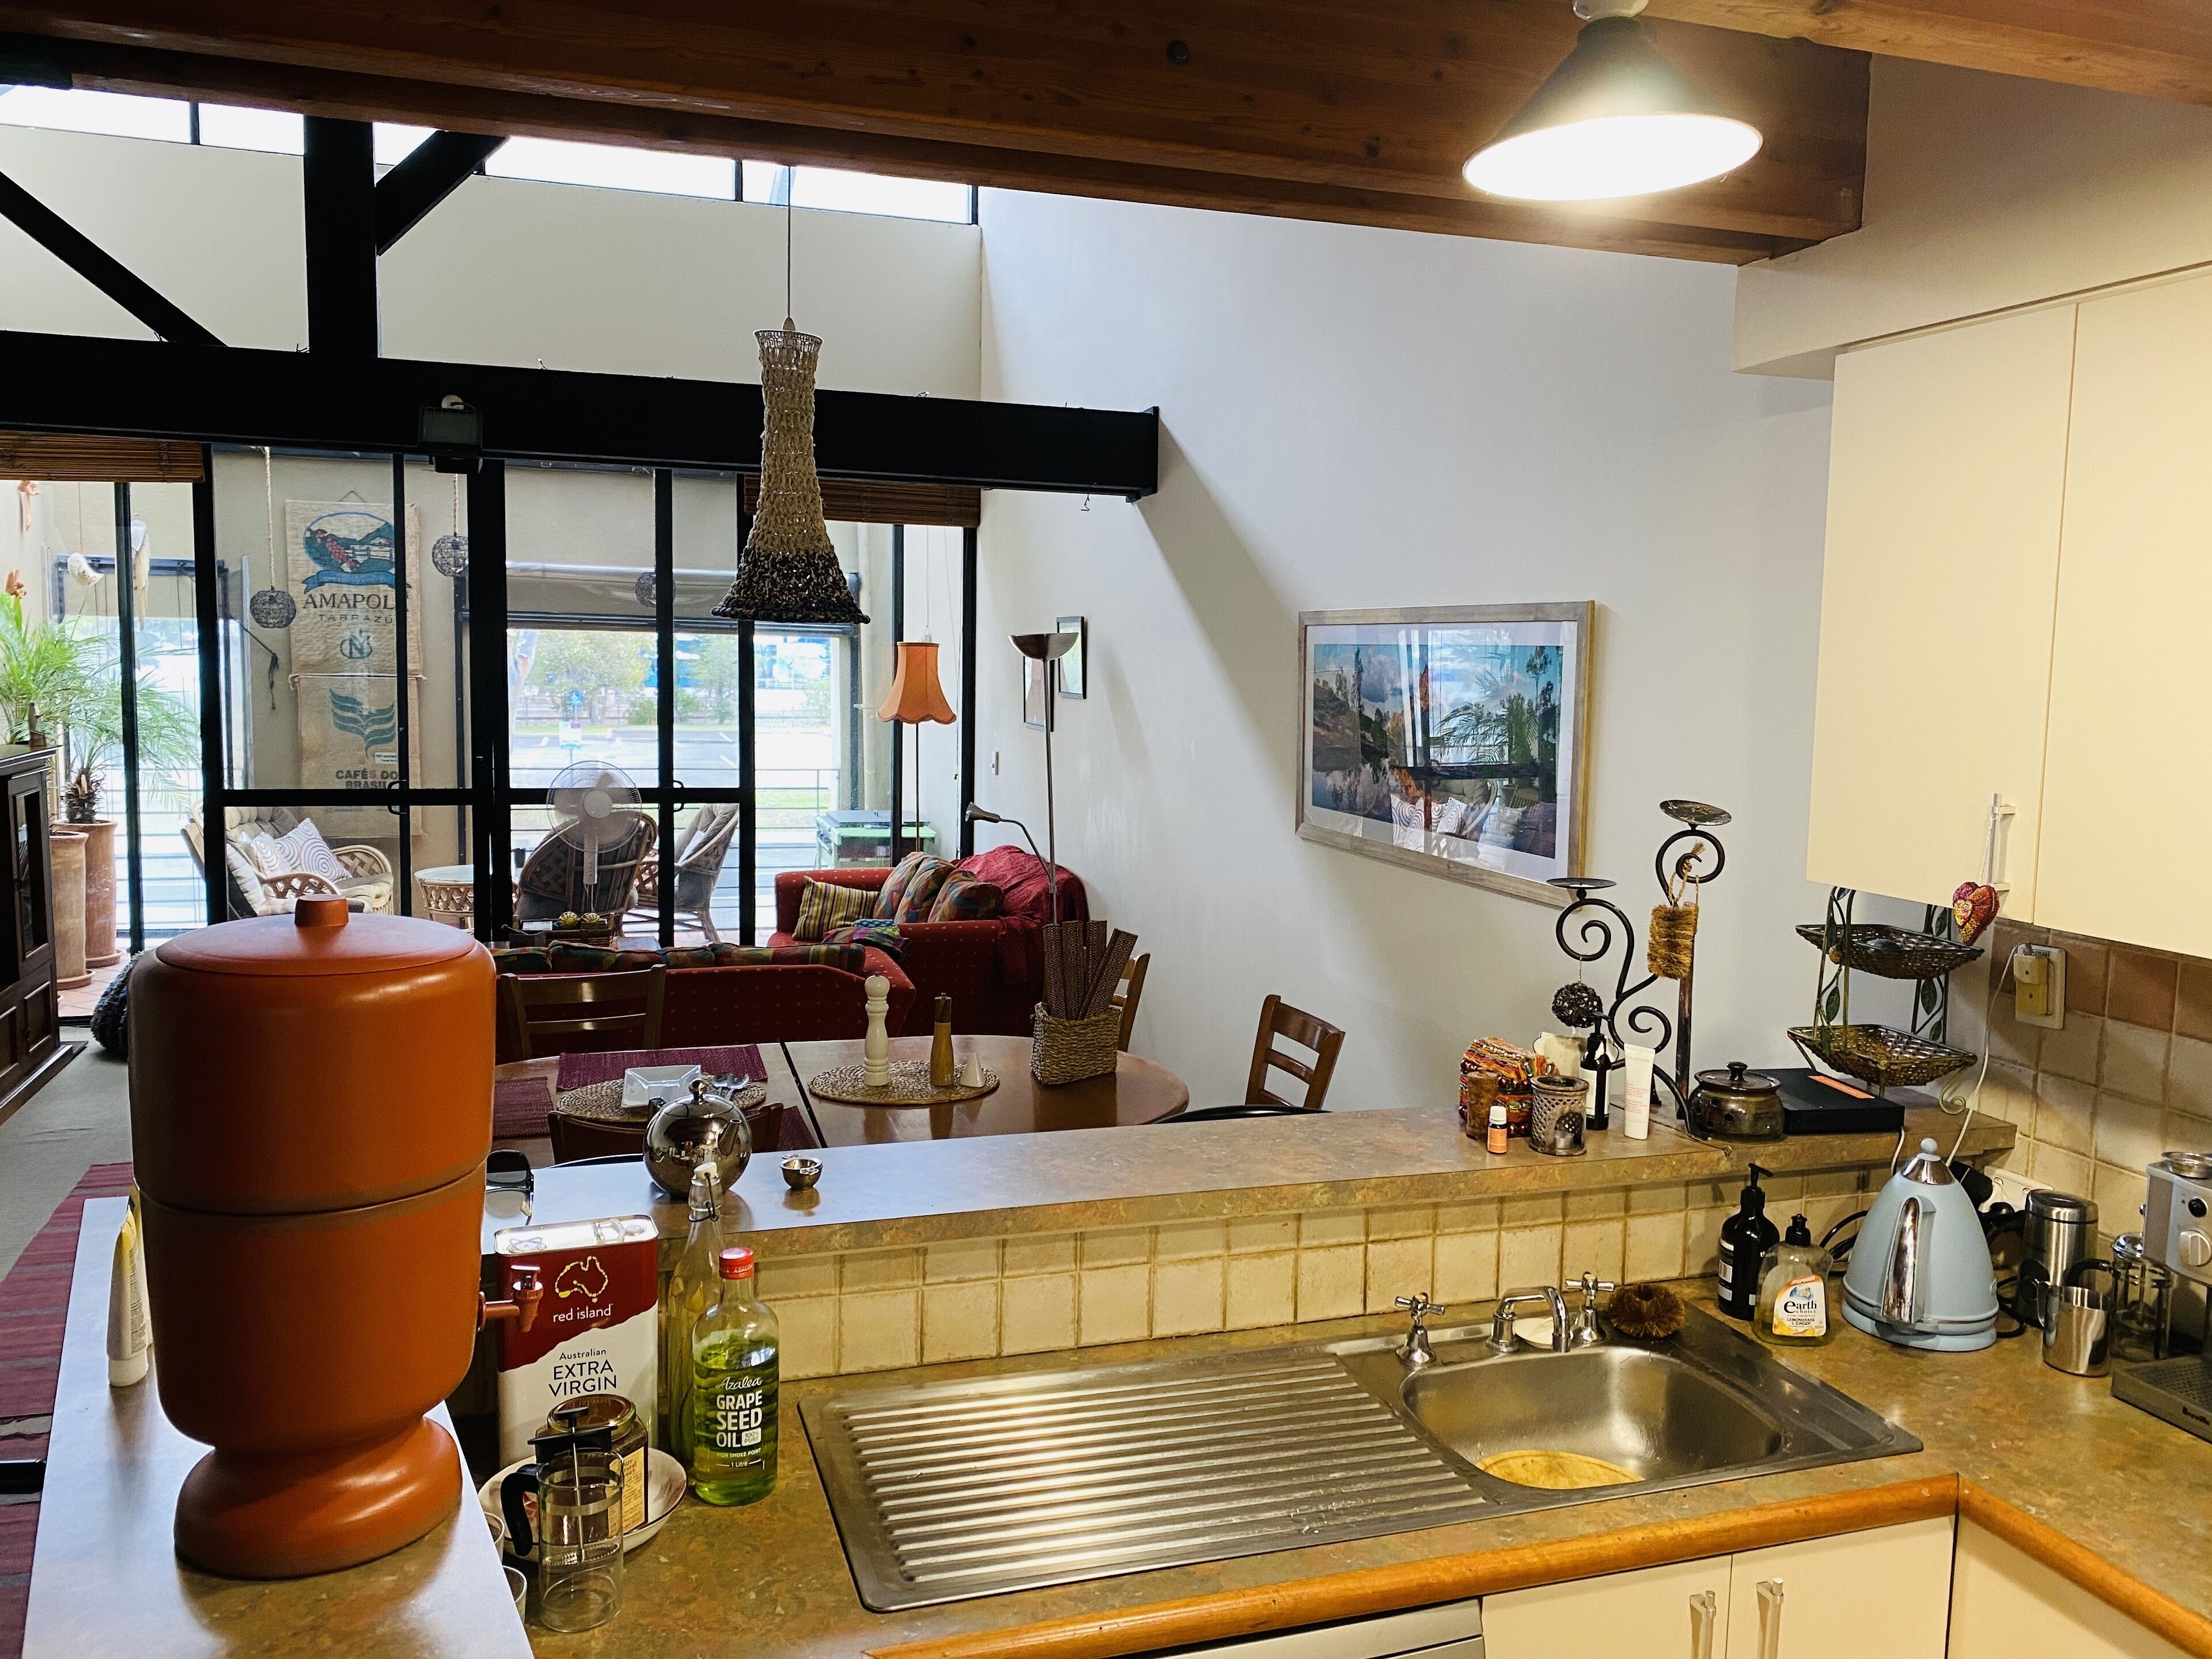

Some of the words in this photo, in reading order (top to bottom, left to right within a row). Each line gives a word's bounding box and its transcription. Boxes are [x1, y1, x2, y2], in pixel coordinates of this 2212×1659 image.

[302, 593, 408, 611] AMAPOL
[335, 768, 377, 779] CAFÉS
[381, 770, 397, 780] DO
[553, 1308, 573, 1323] red
[577, 1303, 612, 1320] island
[1783, 1300, 1817, 1313] earth
[559, 1348, 607, 1361] Australian
[554, 1359, 613, 1380] EXTRA
[548, 1374, 617, 1397] VIRGIN
[715, 1376, 763, 1391] Azalea
[716, 1389, 763, 1410] GRAPE
[716, 1407, 762, 1431] SEED
[716, 1432, 741, 1448] OIL
[748, 1447, 762, 1456] POINT
